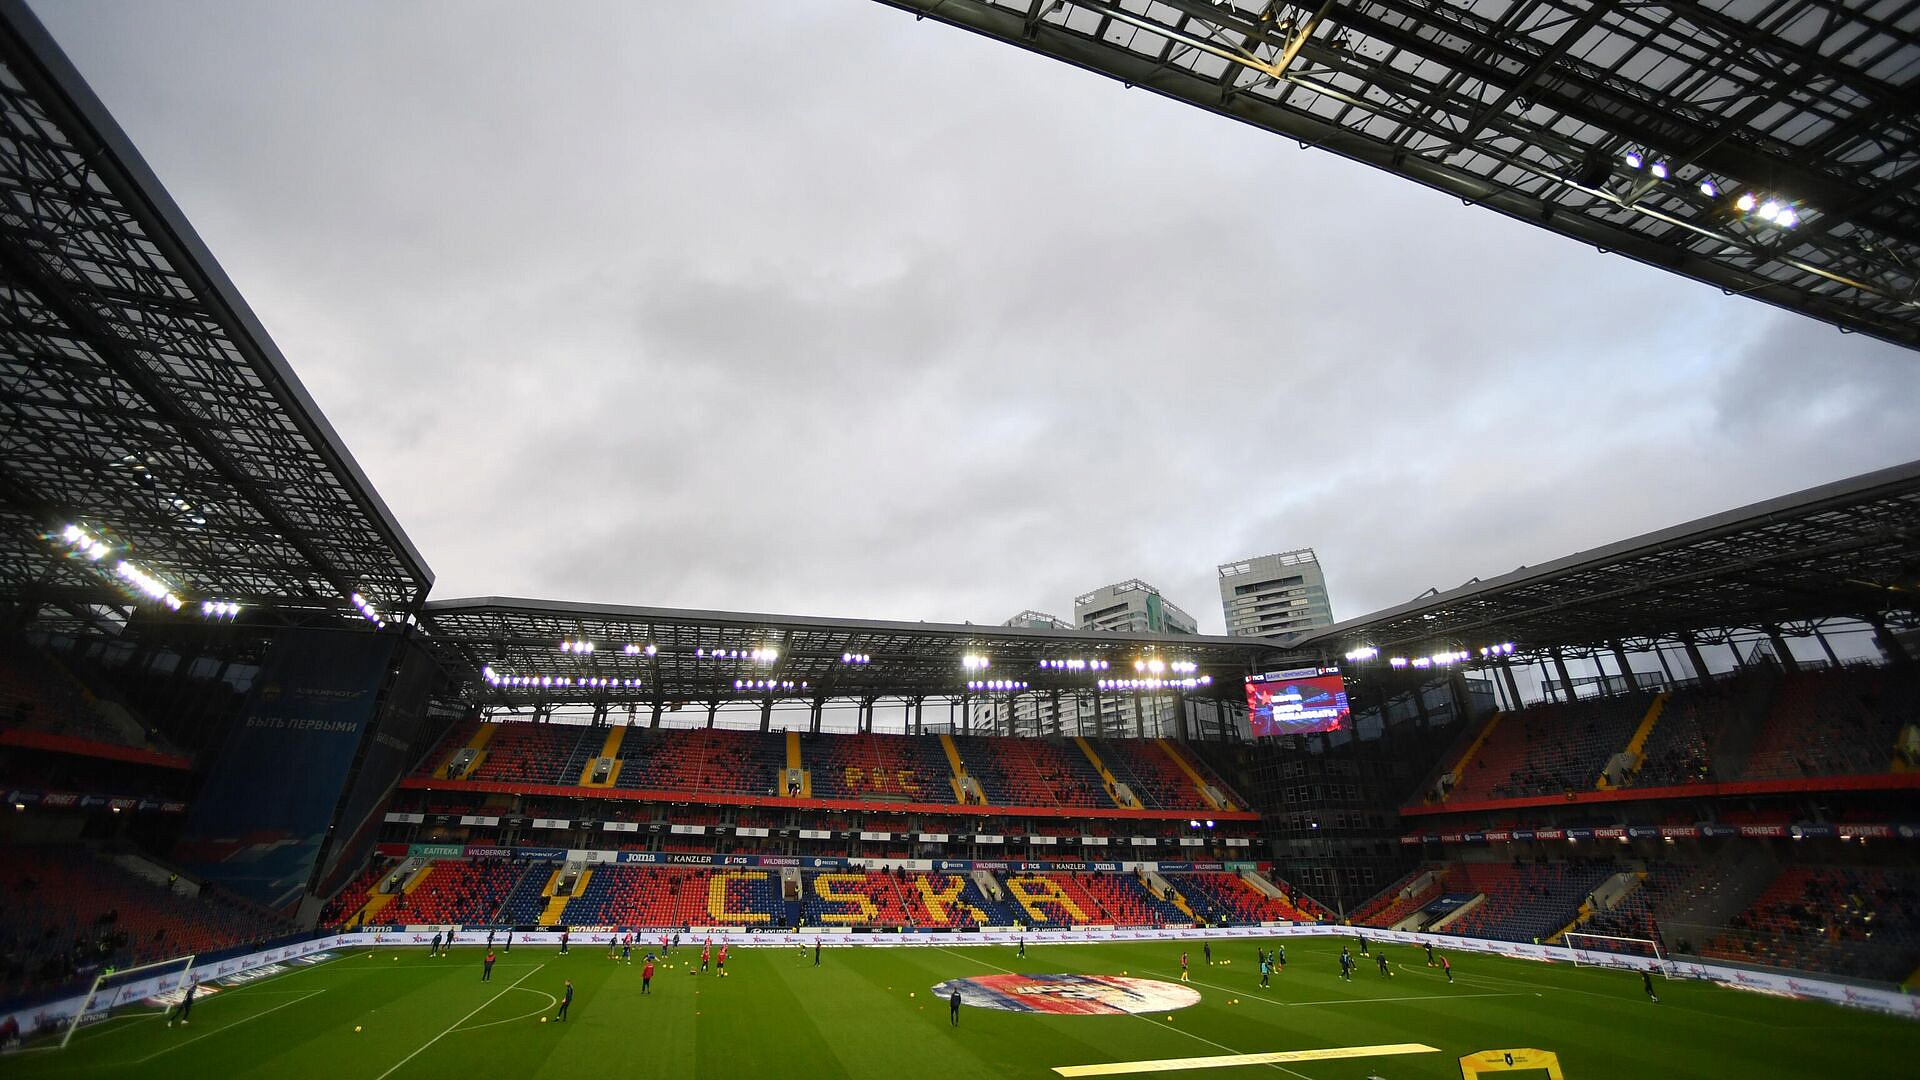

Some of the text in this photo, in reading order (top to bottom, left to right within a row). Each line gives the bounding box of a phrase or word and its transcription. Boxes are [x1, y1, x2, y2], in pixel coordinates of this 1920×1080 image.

[246, 717, 358, 733] БЫТЬ ПЕРВЫМИ
[1595, 828, 1623, 837] FONBET
[1741, 826, 1781, 835] FONBET
[1484, 833, 1508, 841] FONBET
[1535, 831, 1562, 839] FONBET
[468, 848, 511, 857] WILDBERRIES
[674, 857, 713, 865] KANZLER
[763, 858, 801, 866] WILDBERRIES
[1056, 863, 1087, 871] KANZLER
